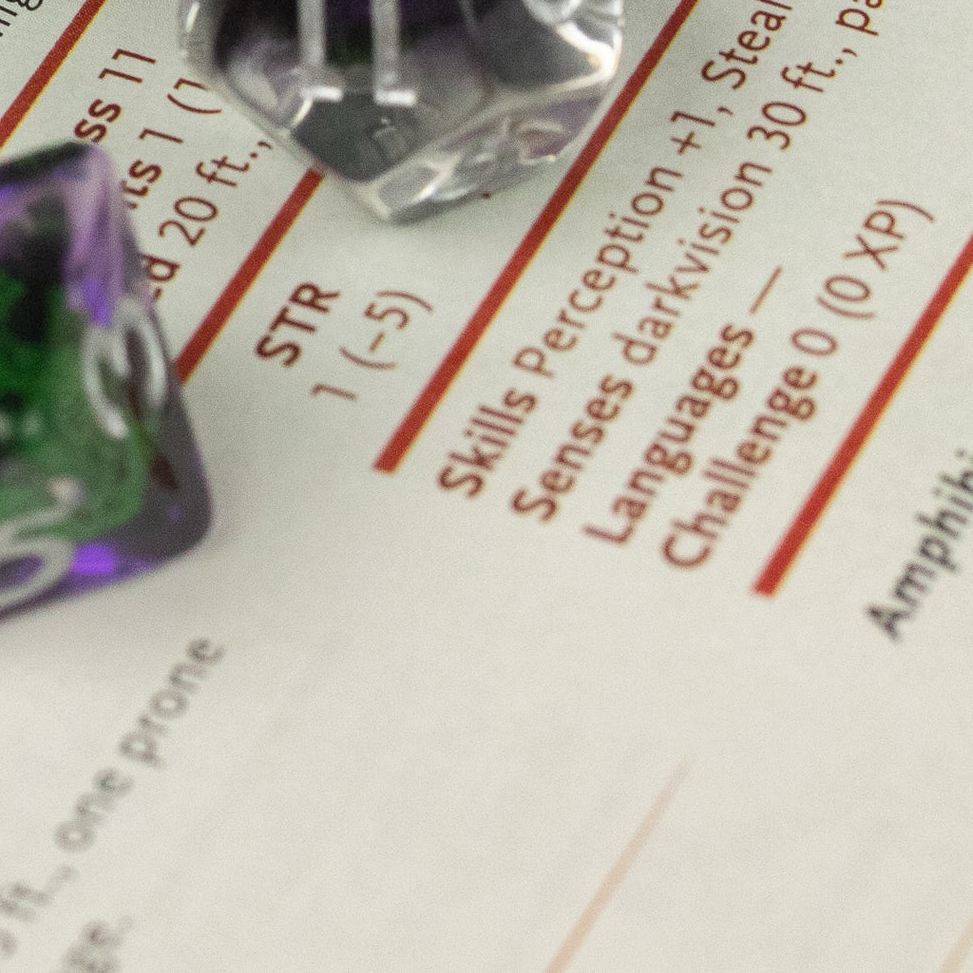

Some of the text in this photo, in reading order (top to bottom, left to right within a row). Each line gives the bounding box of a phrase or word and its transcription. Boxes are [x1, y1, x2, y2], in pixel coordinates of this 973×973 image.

[98, 48, 157, 84] 11
[159, 196, 219, 248] 20
[255, 281, 342, 368] STR
[437, 387, 538, 499] Skills
[512, 165, 684, 379] Perception
[669, 106, 734, 156] +1,
[510, 373, 635, 523] Senses
[611, 161, 773, 366] darkvision
[746, 100, 808, 151] 30
[309, 382, 359, 402] 1
[581, 324, 756, 545] Languages
[659, 365, 819, 570] Challenge
[789, 327, 840, 358] 0
[843, 198, 936, 272] XP)
[55, 766, 136, 854] one
[118, 635, 226, 770] prone
